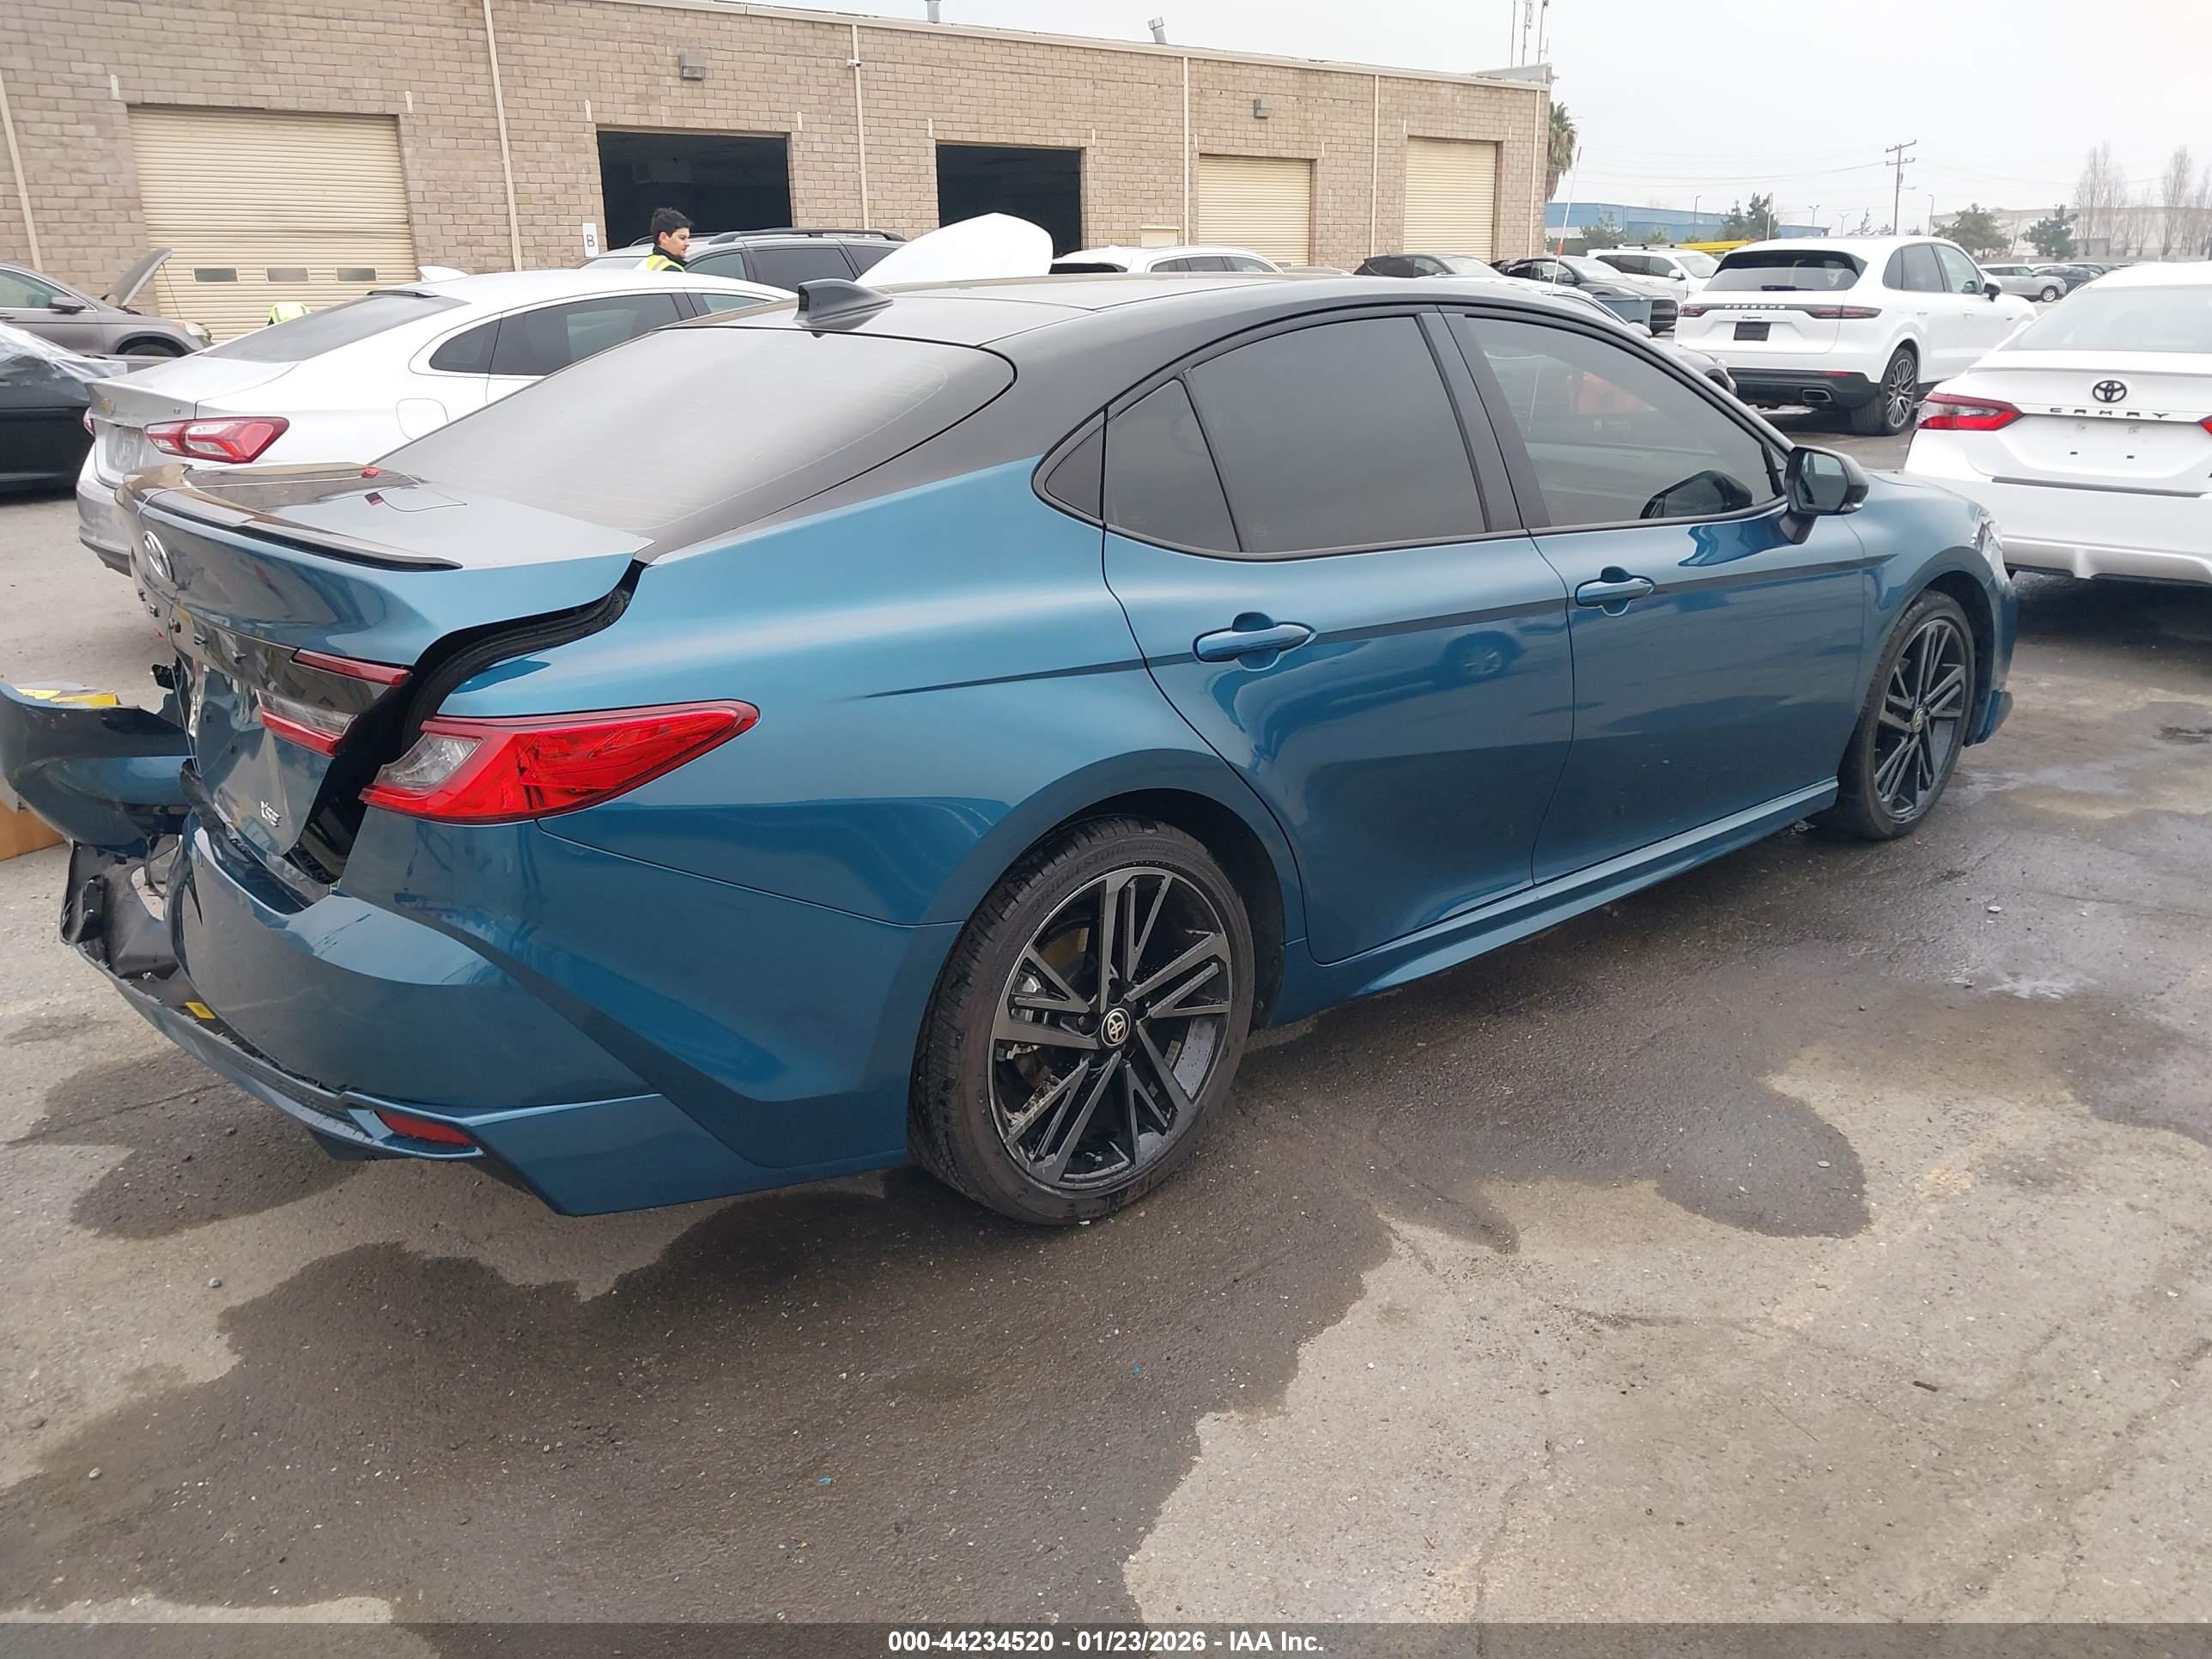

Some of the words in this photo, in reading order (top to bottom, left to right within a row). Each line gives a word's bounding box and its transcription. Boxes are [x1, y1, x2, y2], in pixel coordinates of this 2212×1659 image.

[586, 234, 595, 247] B
[2050, 407, 2170, 419] CAMRY
[260, 799, 282, 828] XSE
